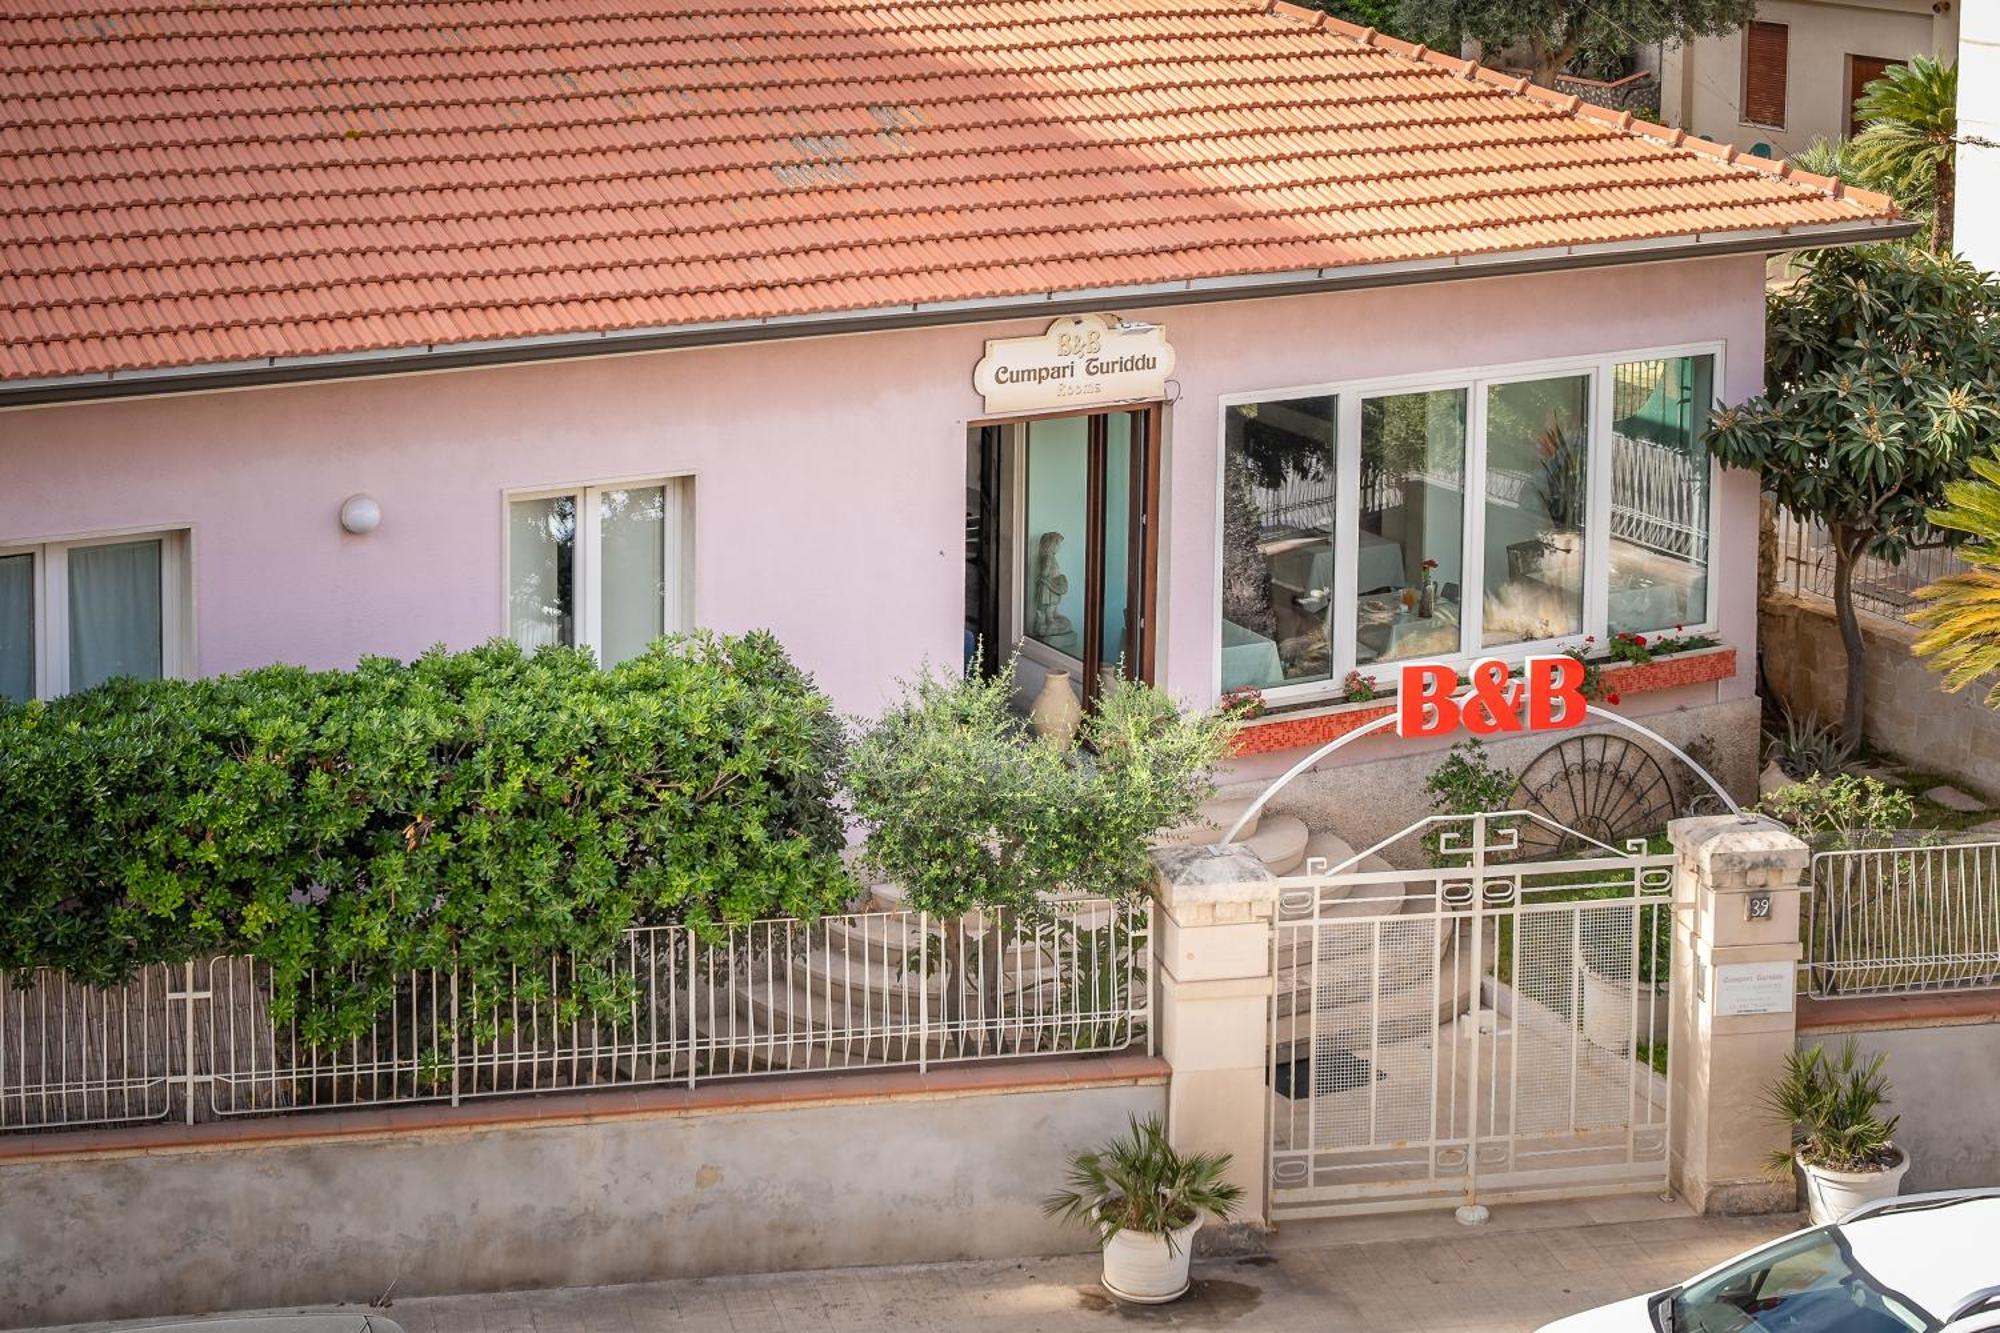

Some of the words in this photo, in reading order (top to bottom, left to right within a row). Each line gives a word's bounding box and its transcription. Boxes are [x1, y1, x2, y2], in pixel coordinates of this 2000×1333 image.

[1056, 331, 1101, 359] B&B
[994, 361, 1075, 384] Cumpari
[1085, 354, 1157, 376] Turiddu
[1056, 383, 1102, 398] Rooms
[1398, 655, 1588, 738] B&B
[1751, 899, 1769, 917] 39
